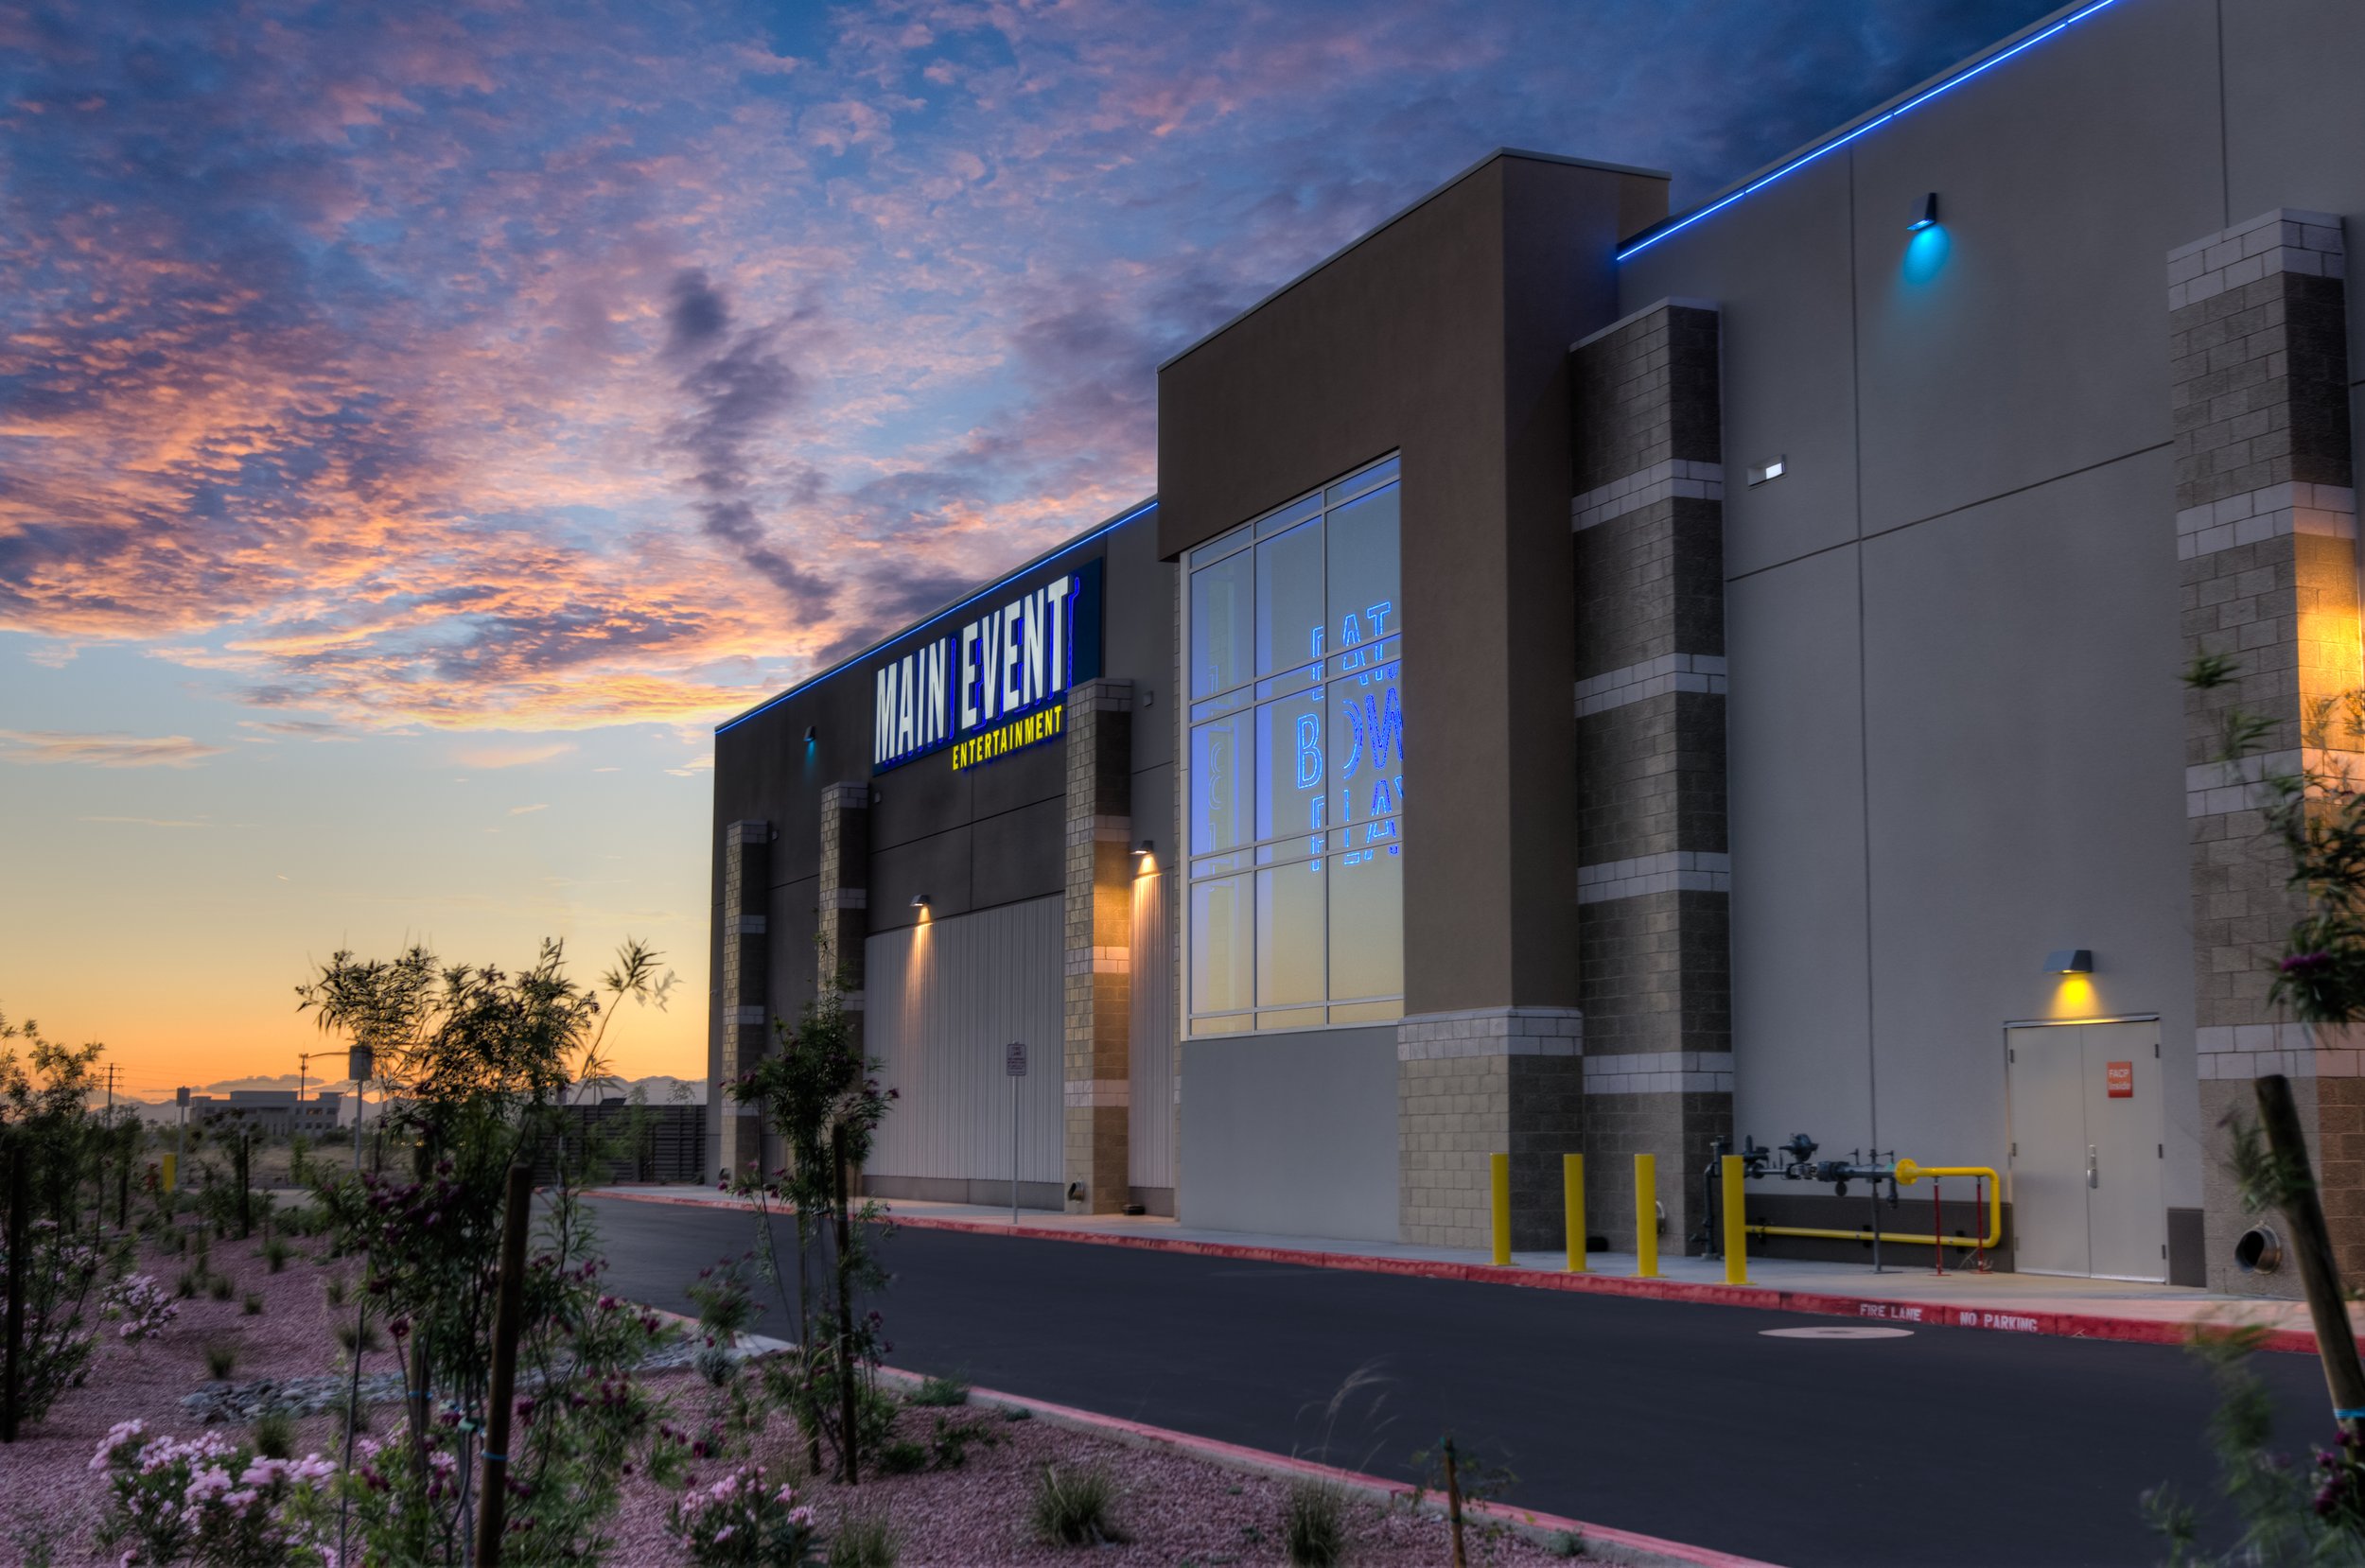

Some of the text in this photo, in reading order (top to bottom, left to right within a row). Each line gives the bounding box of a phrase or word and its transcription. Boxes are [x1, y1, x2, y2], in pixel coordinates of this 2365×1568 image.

[875, 575, 1070, 764] MAIN EVENT
[953, 705, 1062, 771] ENTERTAINMENT
[1859, 1303, 1922, 1322] FIRE LANE
[1959, 1312, 2039, 1333] NO PARKING
